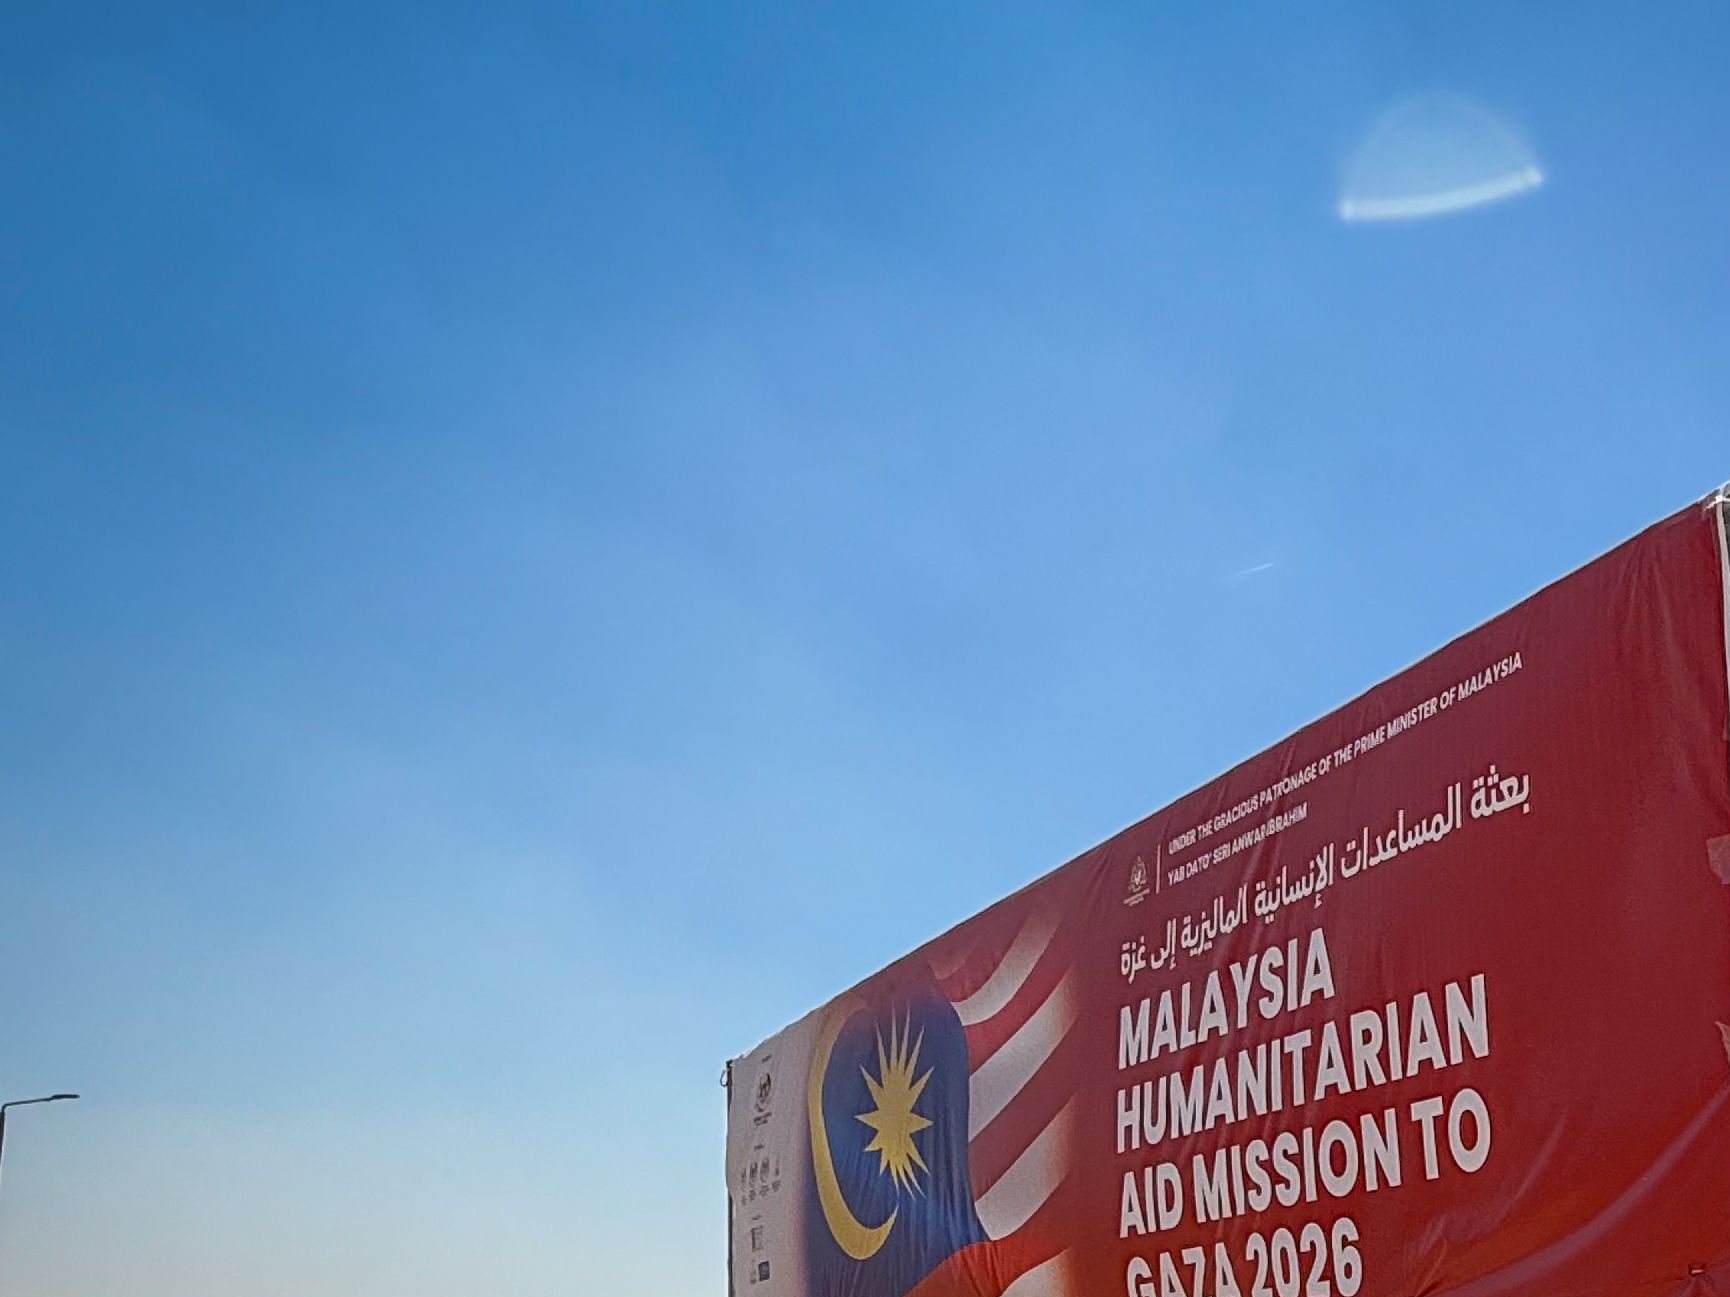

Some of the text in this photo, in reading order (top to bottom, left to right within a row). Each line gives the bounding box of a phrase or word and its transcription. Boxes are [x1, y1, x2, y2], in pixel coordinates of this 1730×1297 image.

[1168, 651, 1523, 855] UNDER THE GRACIOUS PATRONAGE OF THE PRIME MINISTER OF MALAYSIA
[1120, 764, 1531, 985] بعثة المساعدات الإنسانية الماليزية إلى غزة
[1167, 865, 1185, 887] YAB
[1212, 842, 1231, 865] SERI
[1231, 824, 1266, 855] ANWAR
[1265, 802, 1308, 837] IBRAHIM
[1116, 973, 1491, 1154] HUMANITARIAN
[1117, 927, 1336, 1070] MALAYSIA
[1119, 1087, 1492, 1239] AID MISSION TO
